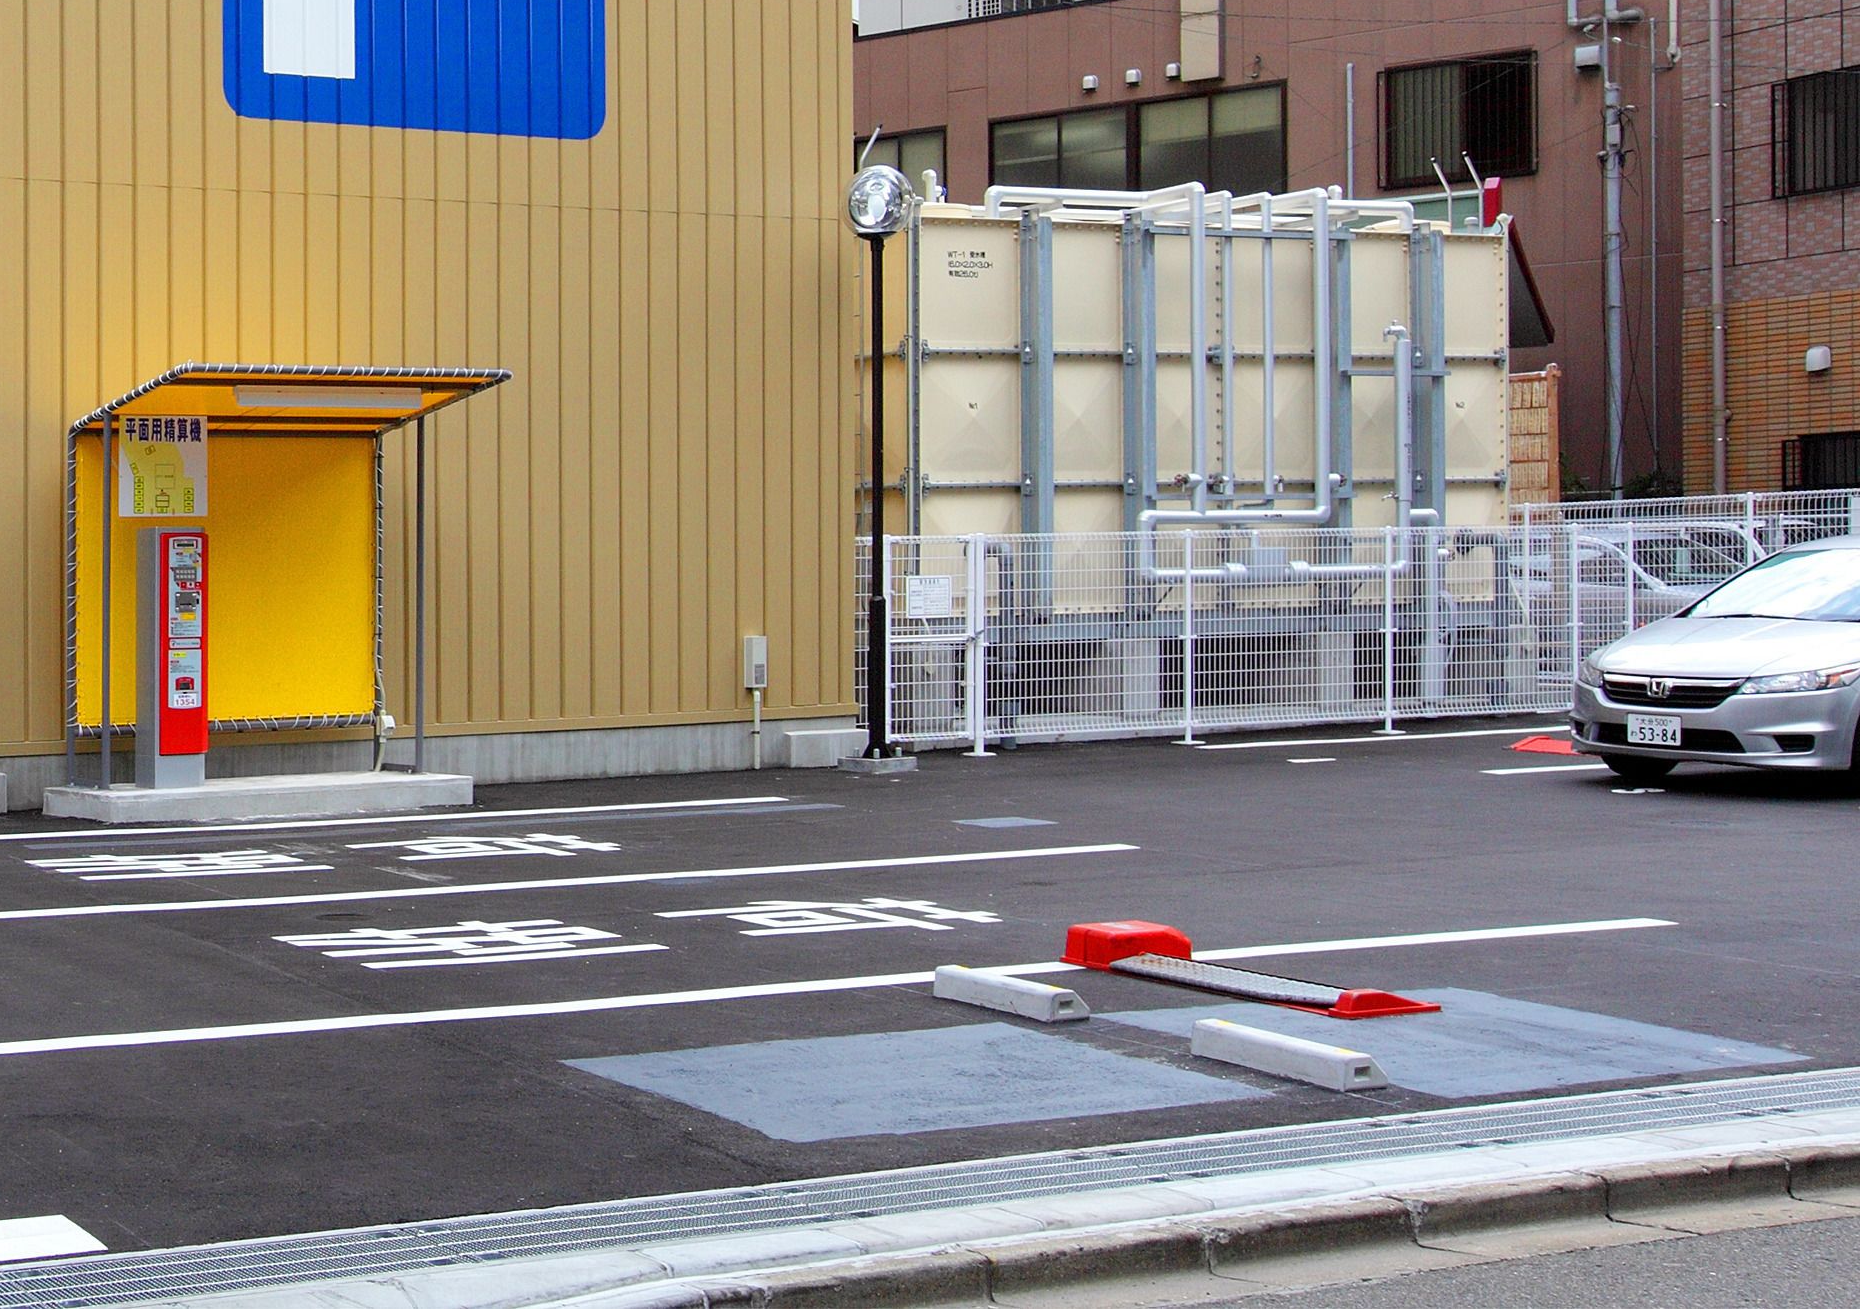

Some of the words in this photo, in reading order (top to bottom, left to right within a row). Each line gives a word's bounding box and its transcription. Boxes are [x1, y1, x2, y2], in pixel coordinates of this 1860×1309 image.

[125, 418, 202, 443] 平面用精算機
[1639, 727, 1677, 743] 53-84
